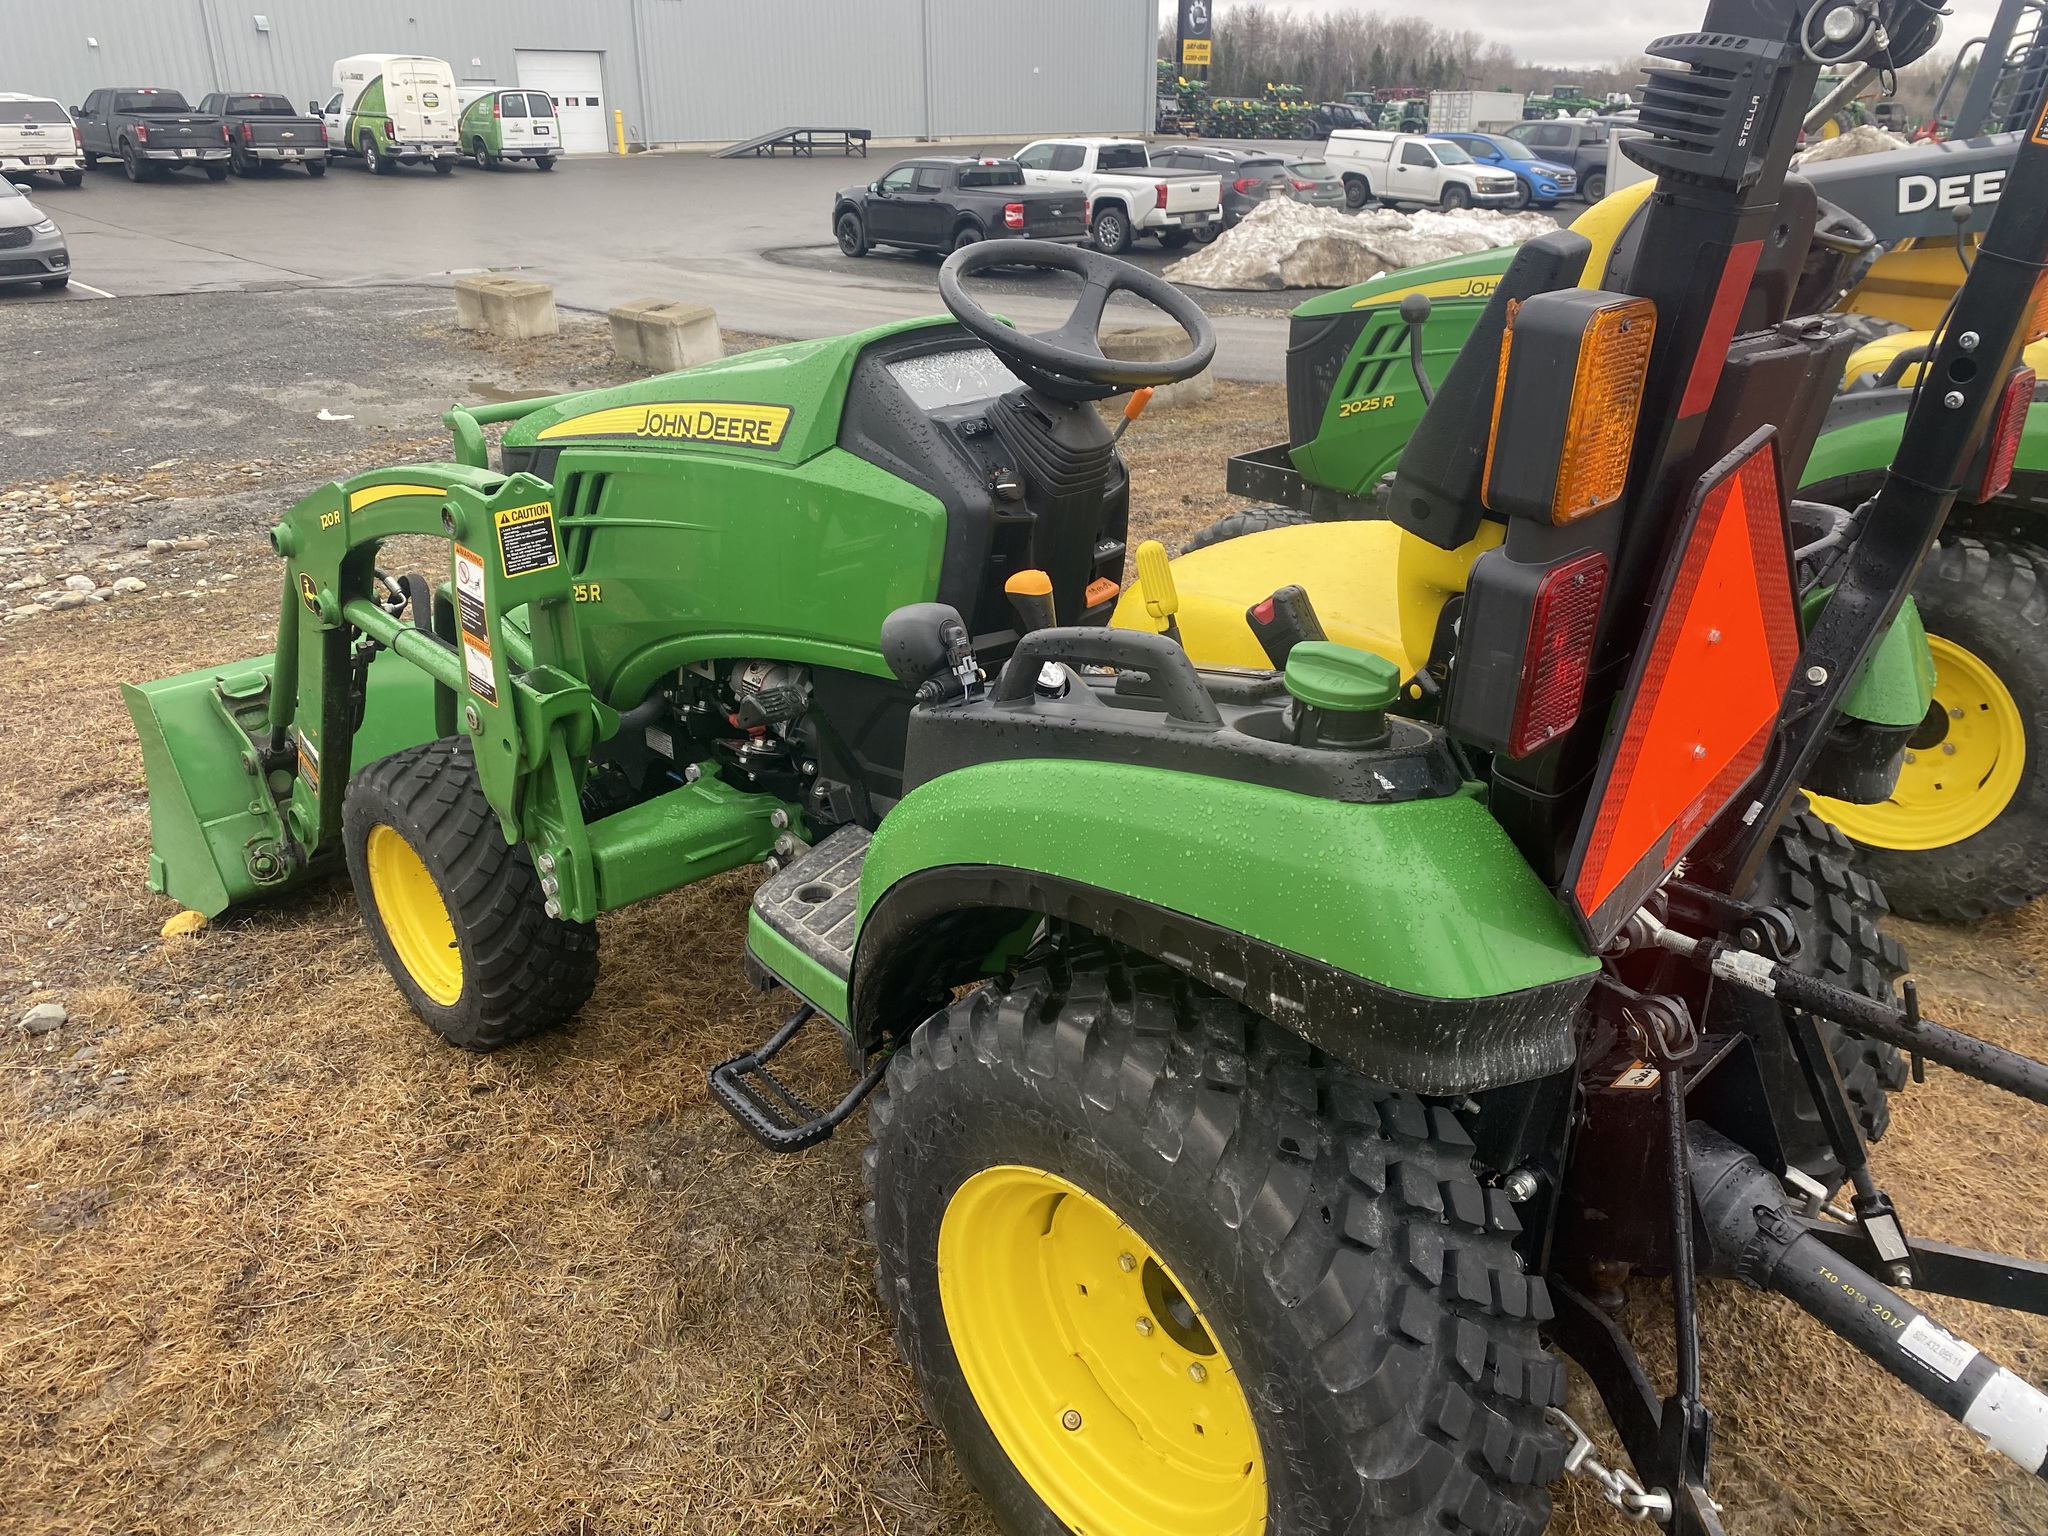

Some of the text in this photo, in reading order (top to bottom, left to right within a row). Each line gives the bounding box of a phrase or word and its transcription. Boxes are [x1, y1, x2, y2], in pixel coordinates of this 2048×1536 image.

[1738, 95, 1760, 147] STELLA
[1898, 170, 2006, 214] DEE
[637, 409, 772, 442] JOHN DEERE
[511, 504, 549, 521] CAUTION
[460, 548, 483, 567] WARNING
[1818, 1266, 1906, 1329] T40 4010 2017
